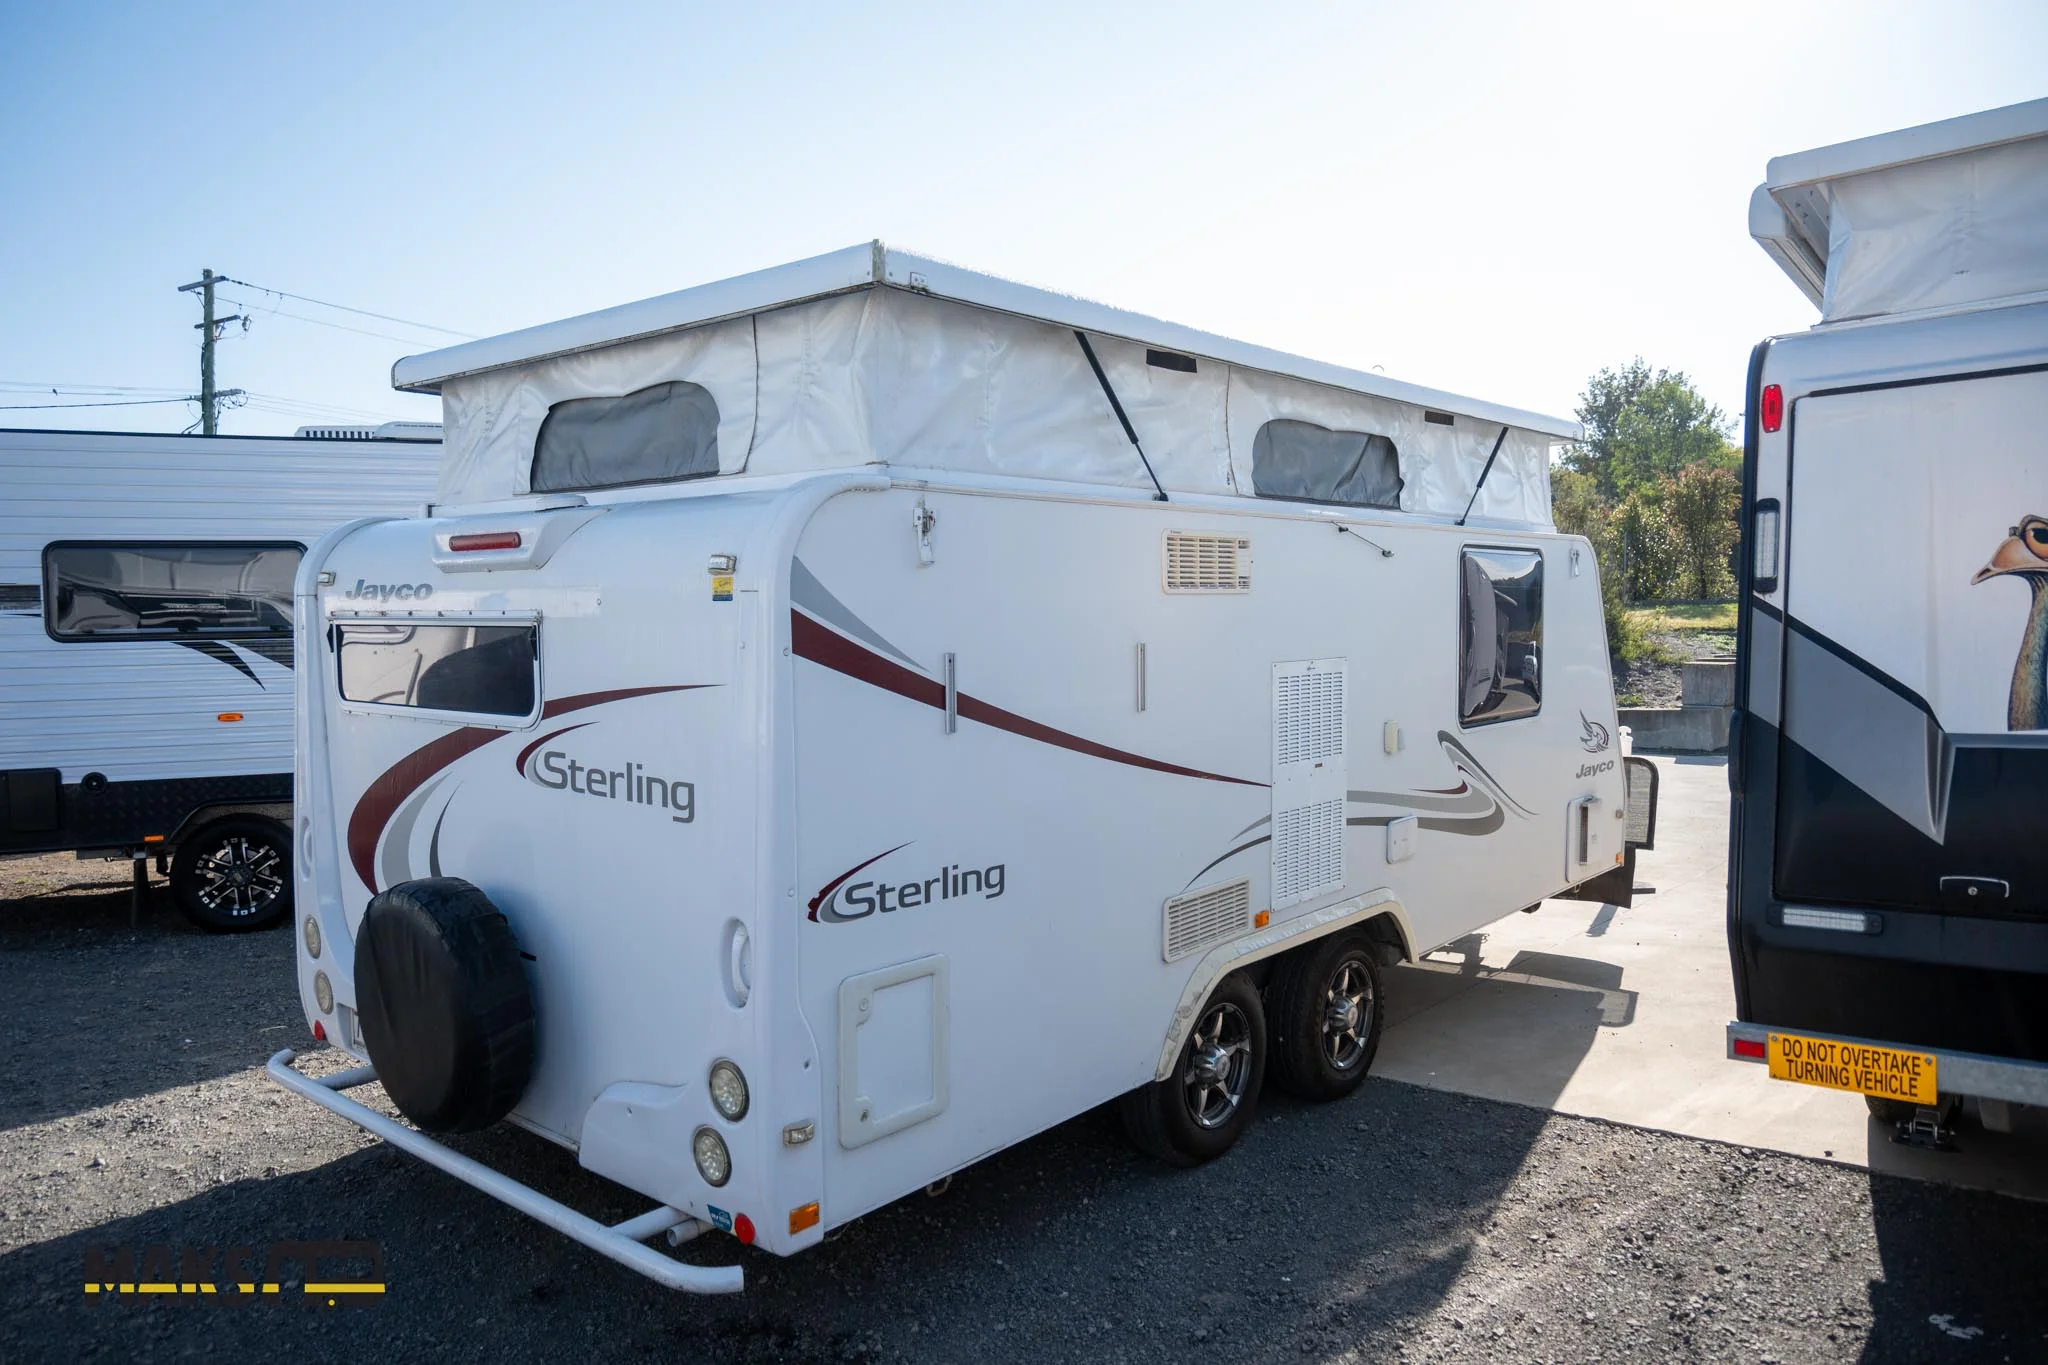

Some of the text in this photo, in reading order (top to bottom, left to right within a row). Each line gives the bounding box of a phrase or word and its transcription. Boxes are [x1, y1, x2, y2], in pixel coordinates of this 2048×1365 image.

[345, 579, 433, 603] Jayco
[541, 750, 695, 823] Sterling
[1576, 760, 1615, 779] Jayco
[841, 864, 1005, 919] Sterling
[1782, 1038, 1921, 1076] DO NOT OVERTAKE
[1786, 1058, 1918, 1097] TURNING VEHICLE
